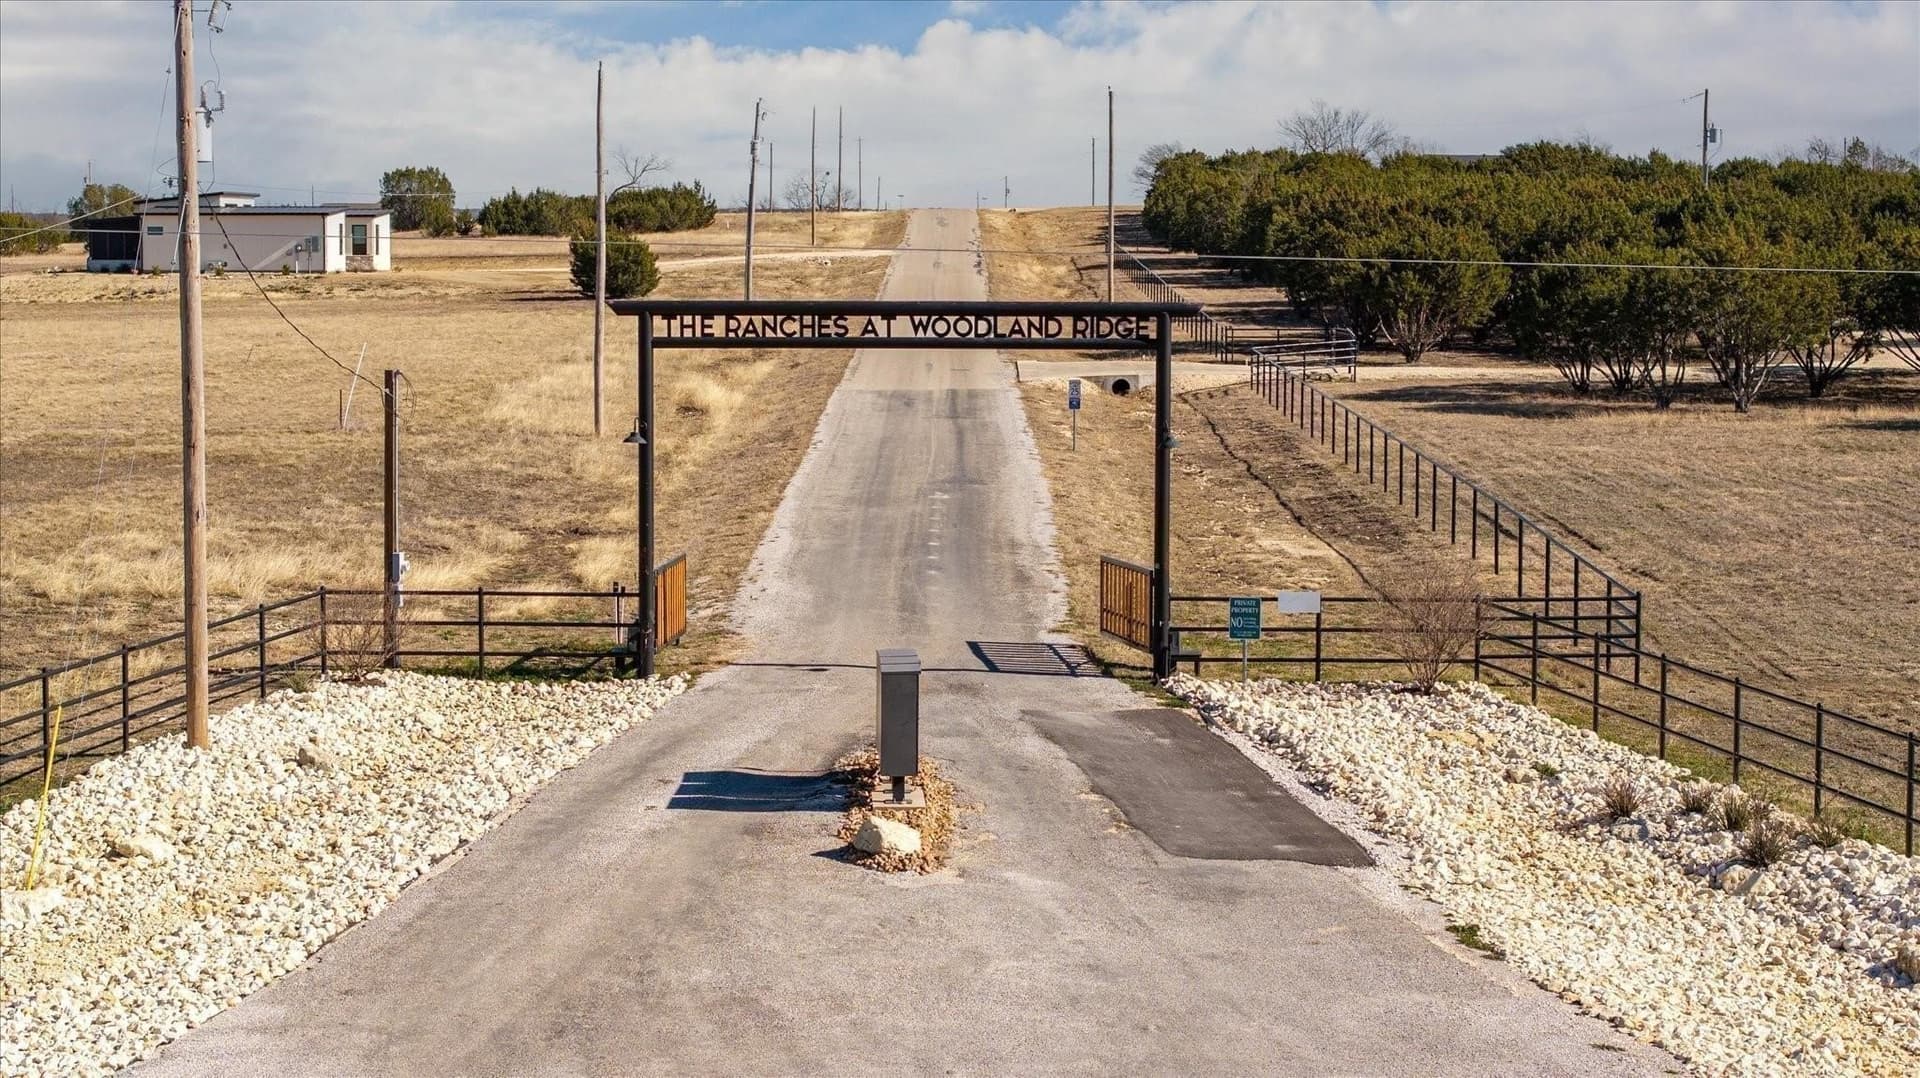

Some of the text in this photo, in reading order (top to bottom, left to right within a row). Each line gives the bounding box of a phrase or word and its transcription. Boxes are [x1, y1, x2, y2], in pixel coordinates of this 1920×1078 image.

[661, 315, 1151, 339] THE RANCHES AT WOODLAND RIDGE
[1231, 616, 1243, 628] NO
